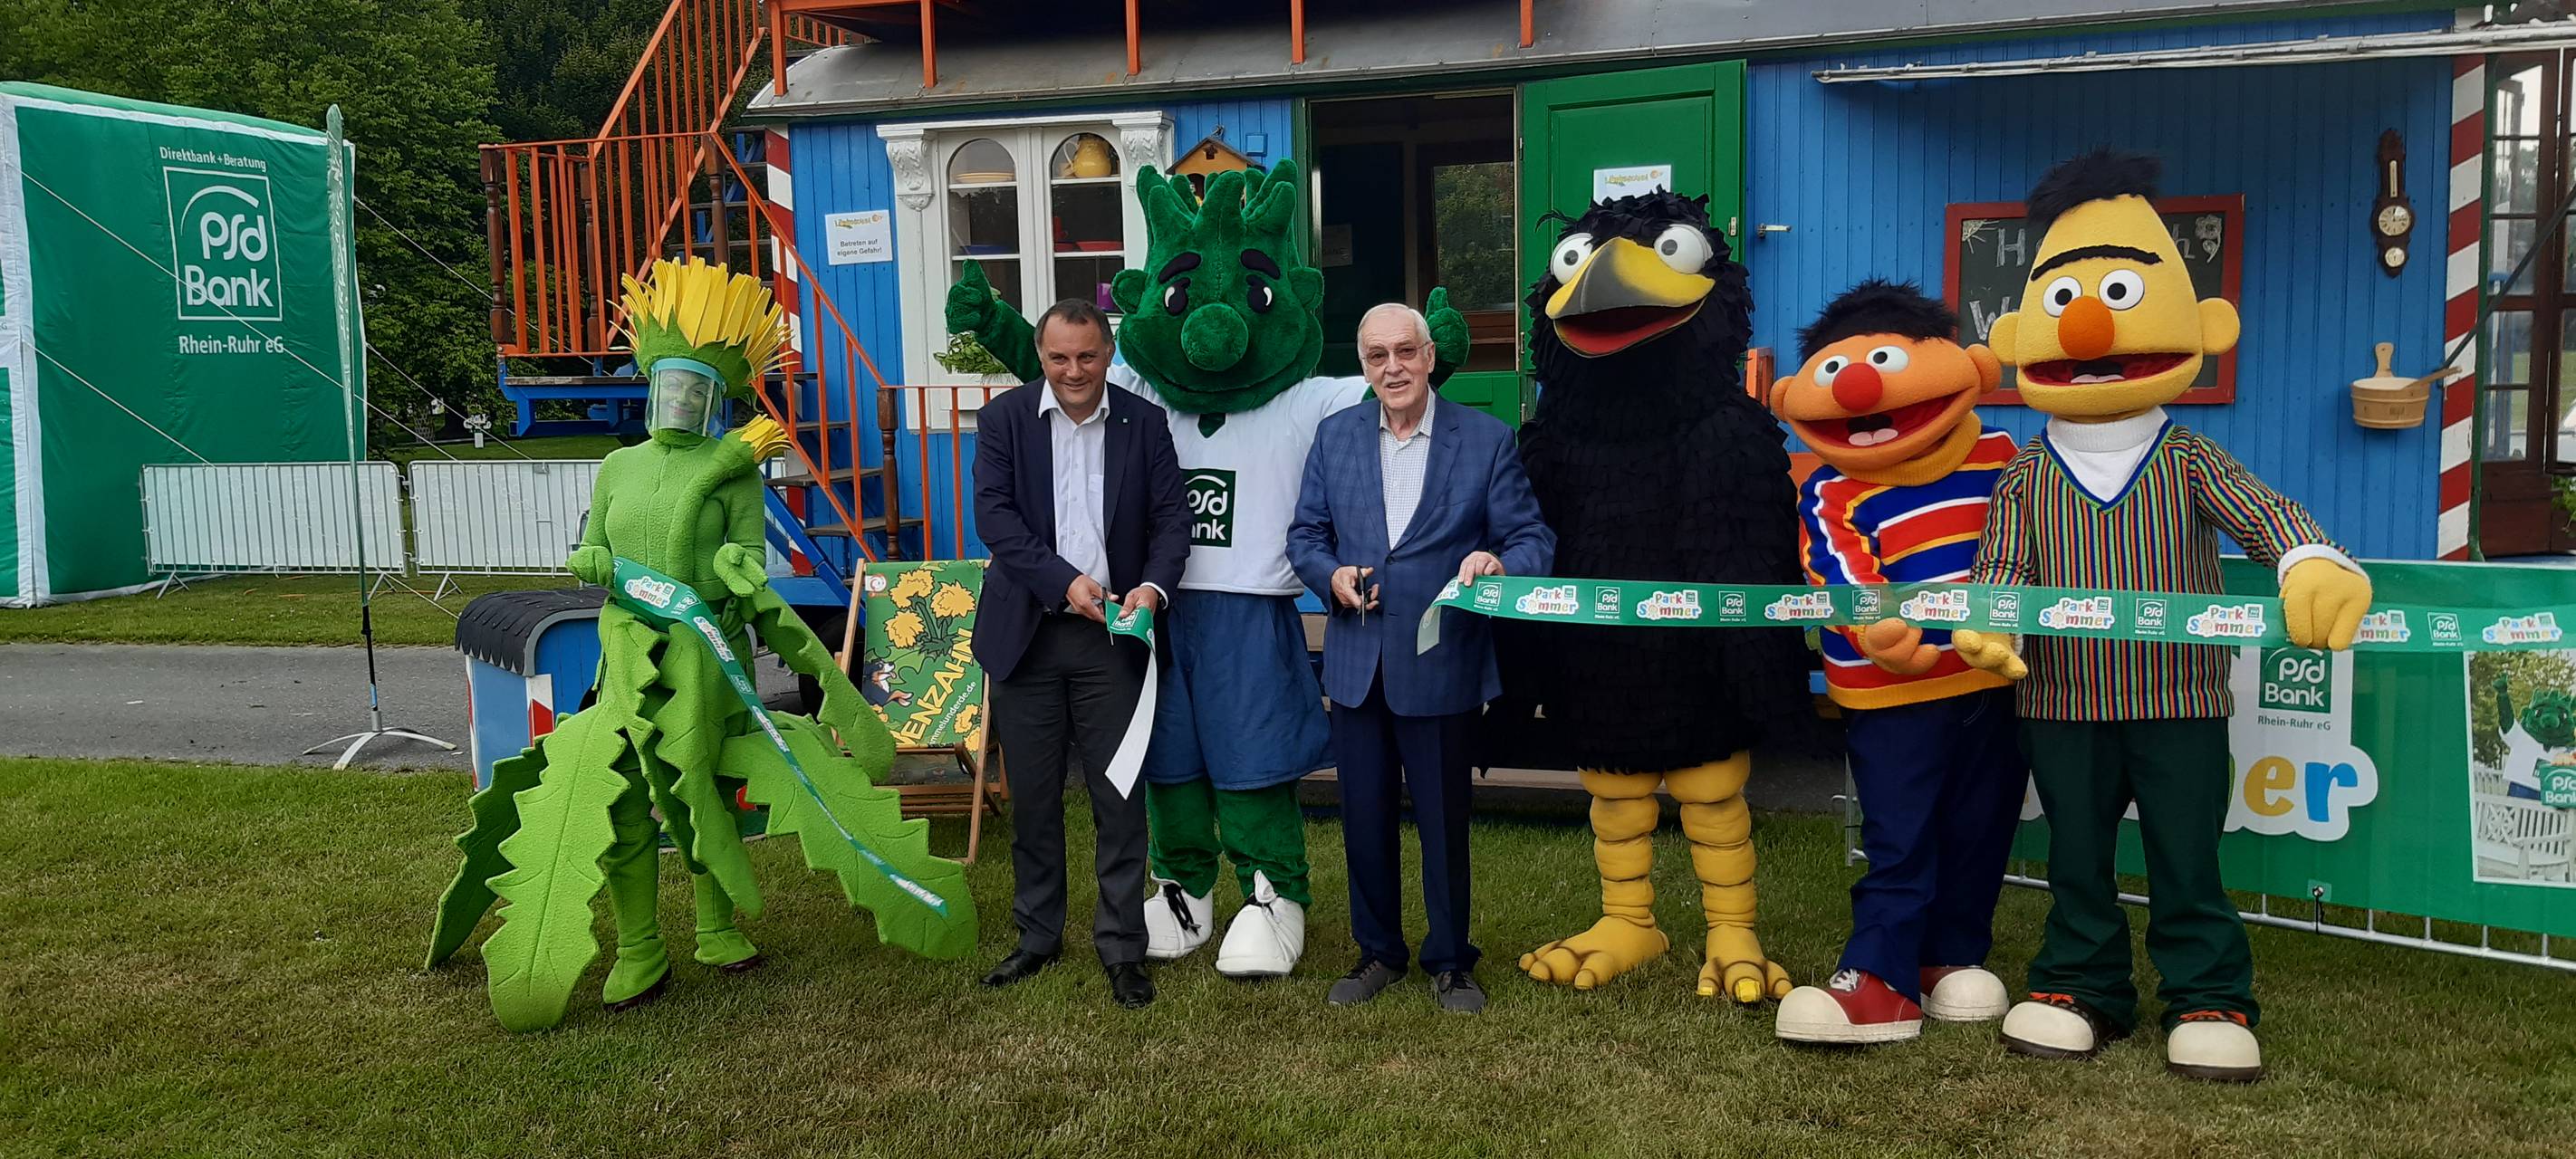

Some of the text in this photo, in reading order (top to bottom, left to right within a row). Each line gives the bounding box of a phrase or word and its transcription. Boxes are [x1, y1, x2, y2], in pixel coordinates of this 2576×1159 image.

[200, 212, 268, 261] psd
[185, 265, 274, 307] Bank
[178, 334, 284, 354] Rhein-Ruhr eG
[1191, 519, 1226, 541] nk
[1535, 589, 1562, 600] Park
[1655, 593, 1683, 605] Park
[1920, 593, 1949, 605] Park
[1597, 602, 1618, 611] Bank
[1783, 596, 1813, 606] Park
[2062, 599, 2093, 612] Park
[1721, 607, 1744, 615] Bank
[1855, 605, 1878, 613] Bank
[1992, 608, 2016, 618] Bank
[2210, 607, 2244, 619] Park
[2138, 616, 2163, 626] Bank
[2362, 616, 2387, 626] ark
[2502, 618, 2536, 627] Park
[2279, 657, 2325, 684] psd
[2264, 683, 2324, 707] Bank
[2257, 714, 2331, 731] Rhein-Ruhr eG
